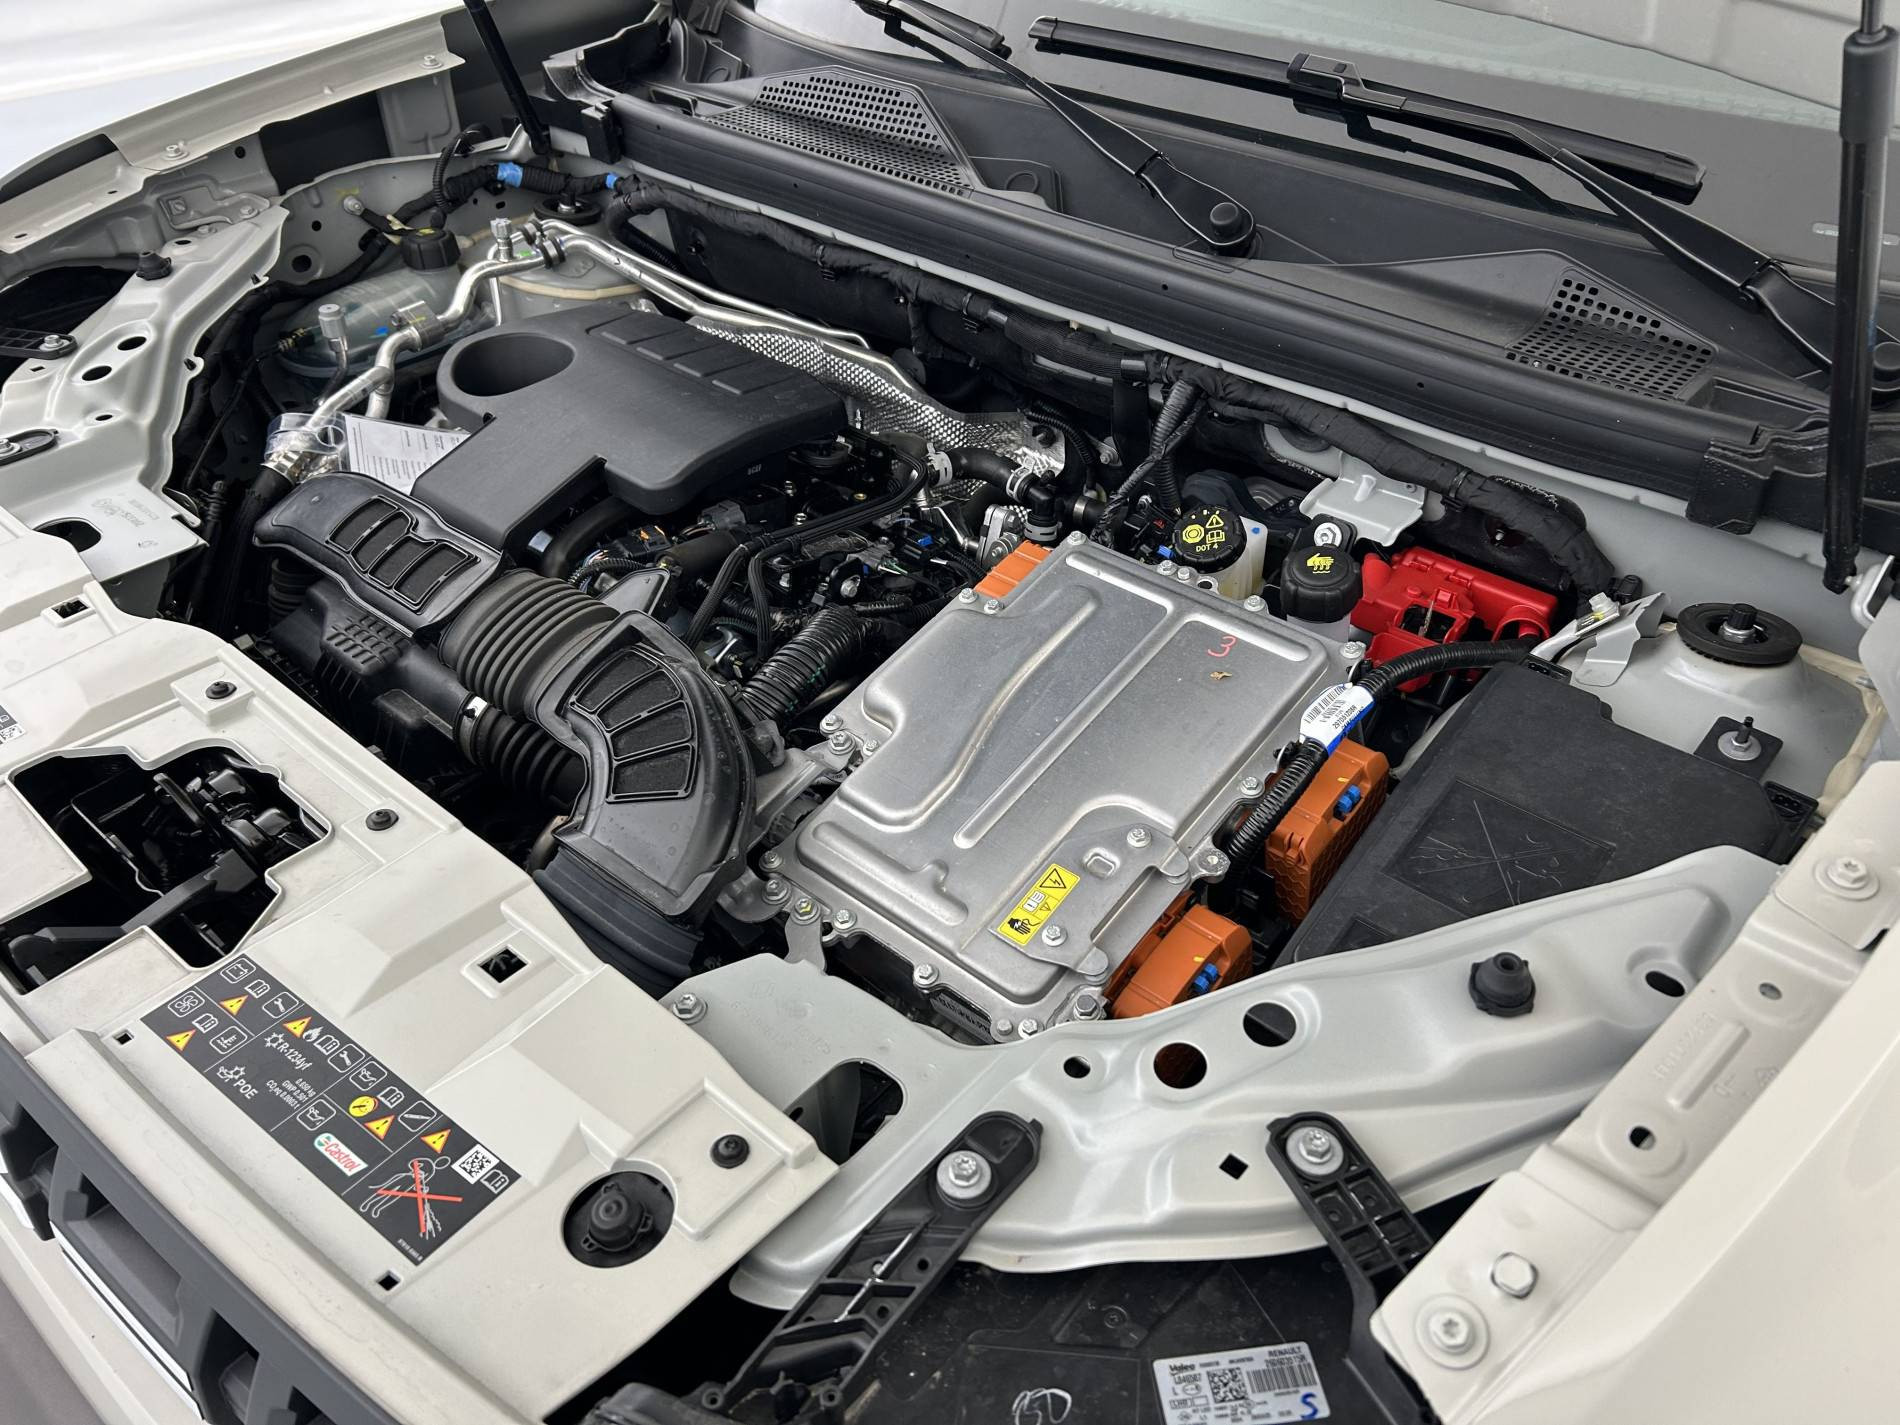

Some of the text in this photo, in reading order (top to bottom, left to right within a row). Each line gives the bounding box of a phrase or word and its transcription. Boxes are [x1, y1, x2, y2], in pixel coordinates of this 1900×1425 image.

[1196, 544, 1211, 552] DOT
[1207, 635, 1236, 657] 3
[277, 1042, 313, 1070] R-1234yf
[233, 1078, 259, 1099] POE
[282, 1080, 297, 1091] GWP
[324, 1143, 361, 1172] Castrol
[1268, 1346, 1302, 1358] RENAULT
[1169, 1362, 1196, 1376] Valeo
